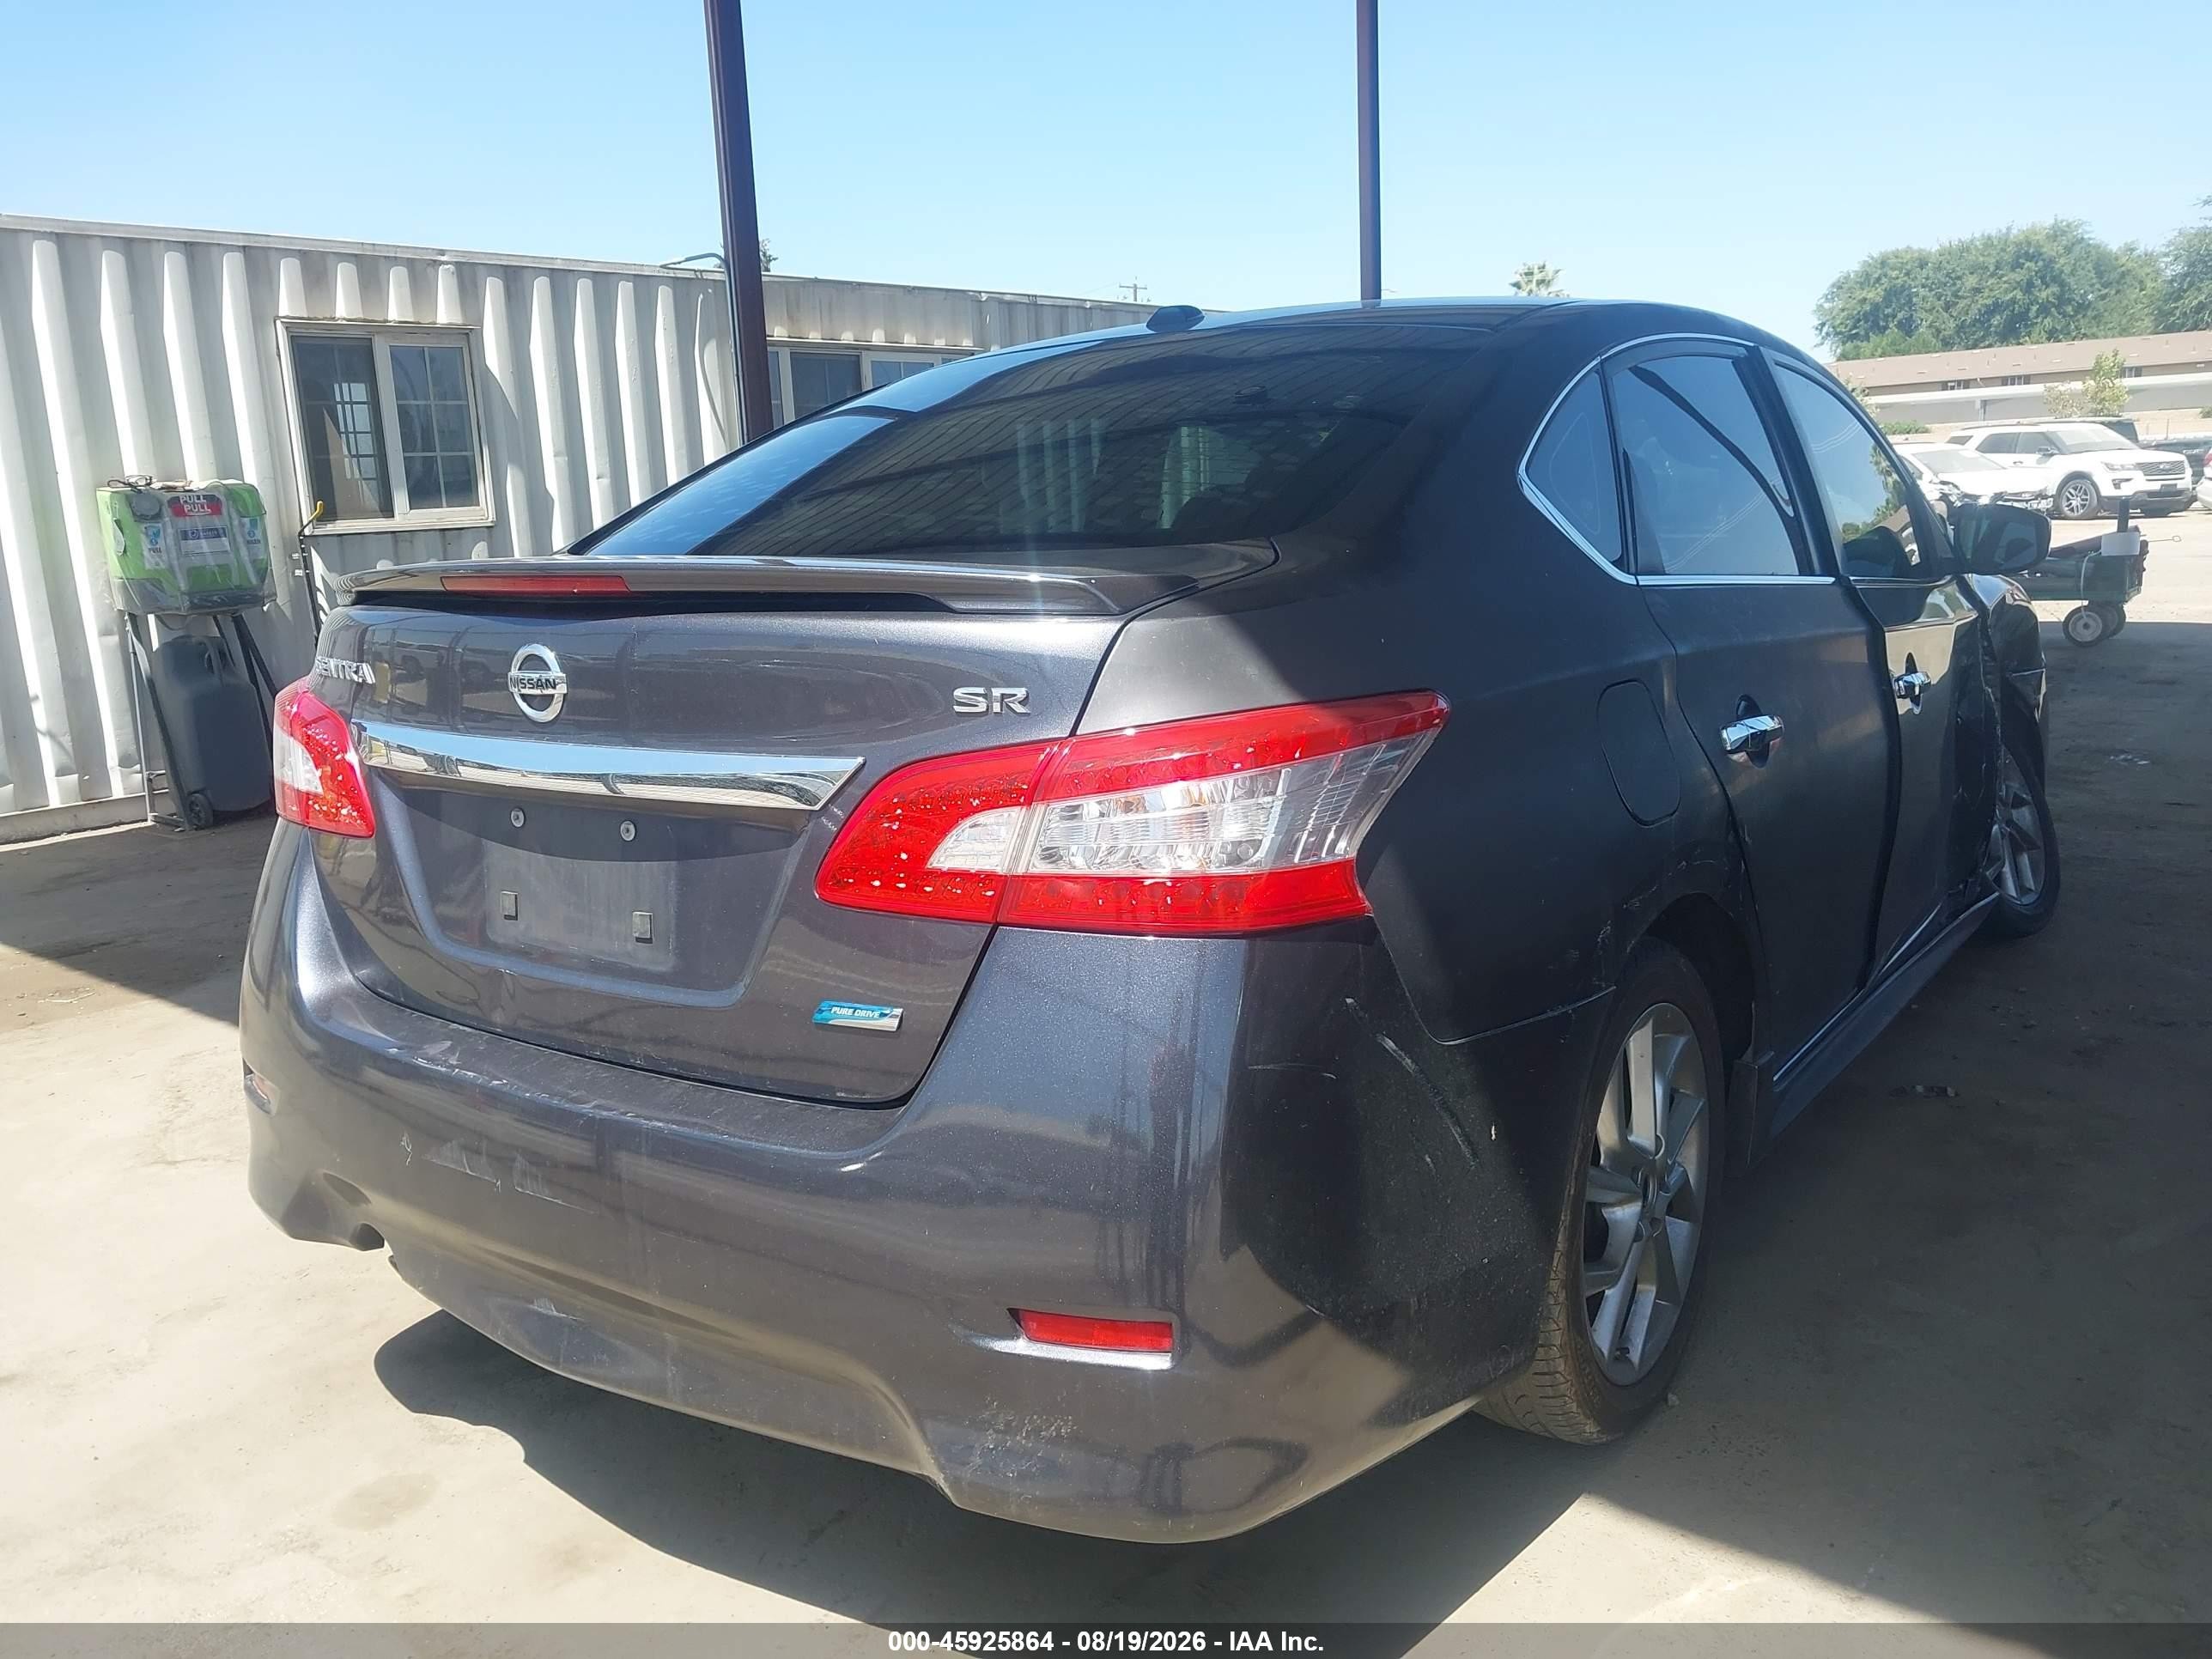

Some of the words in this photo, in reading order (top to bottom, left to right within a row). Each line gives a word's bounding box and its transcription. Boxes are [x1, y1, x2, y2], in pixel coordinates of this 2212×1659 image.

[179, 494, 207, 505] PULL
[184, 503, 211, 514] PULL
[509, 676, 557, 690] NISSAN
[952, 686, 1030, 714] SR
[830, 1006, 854, 1017] PURE
[854, 1009, 881, 1018] DRIVE
